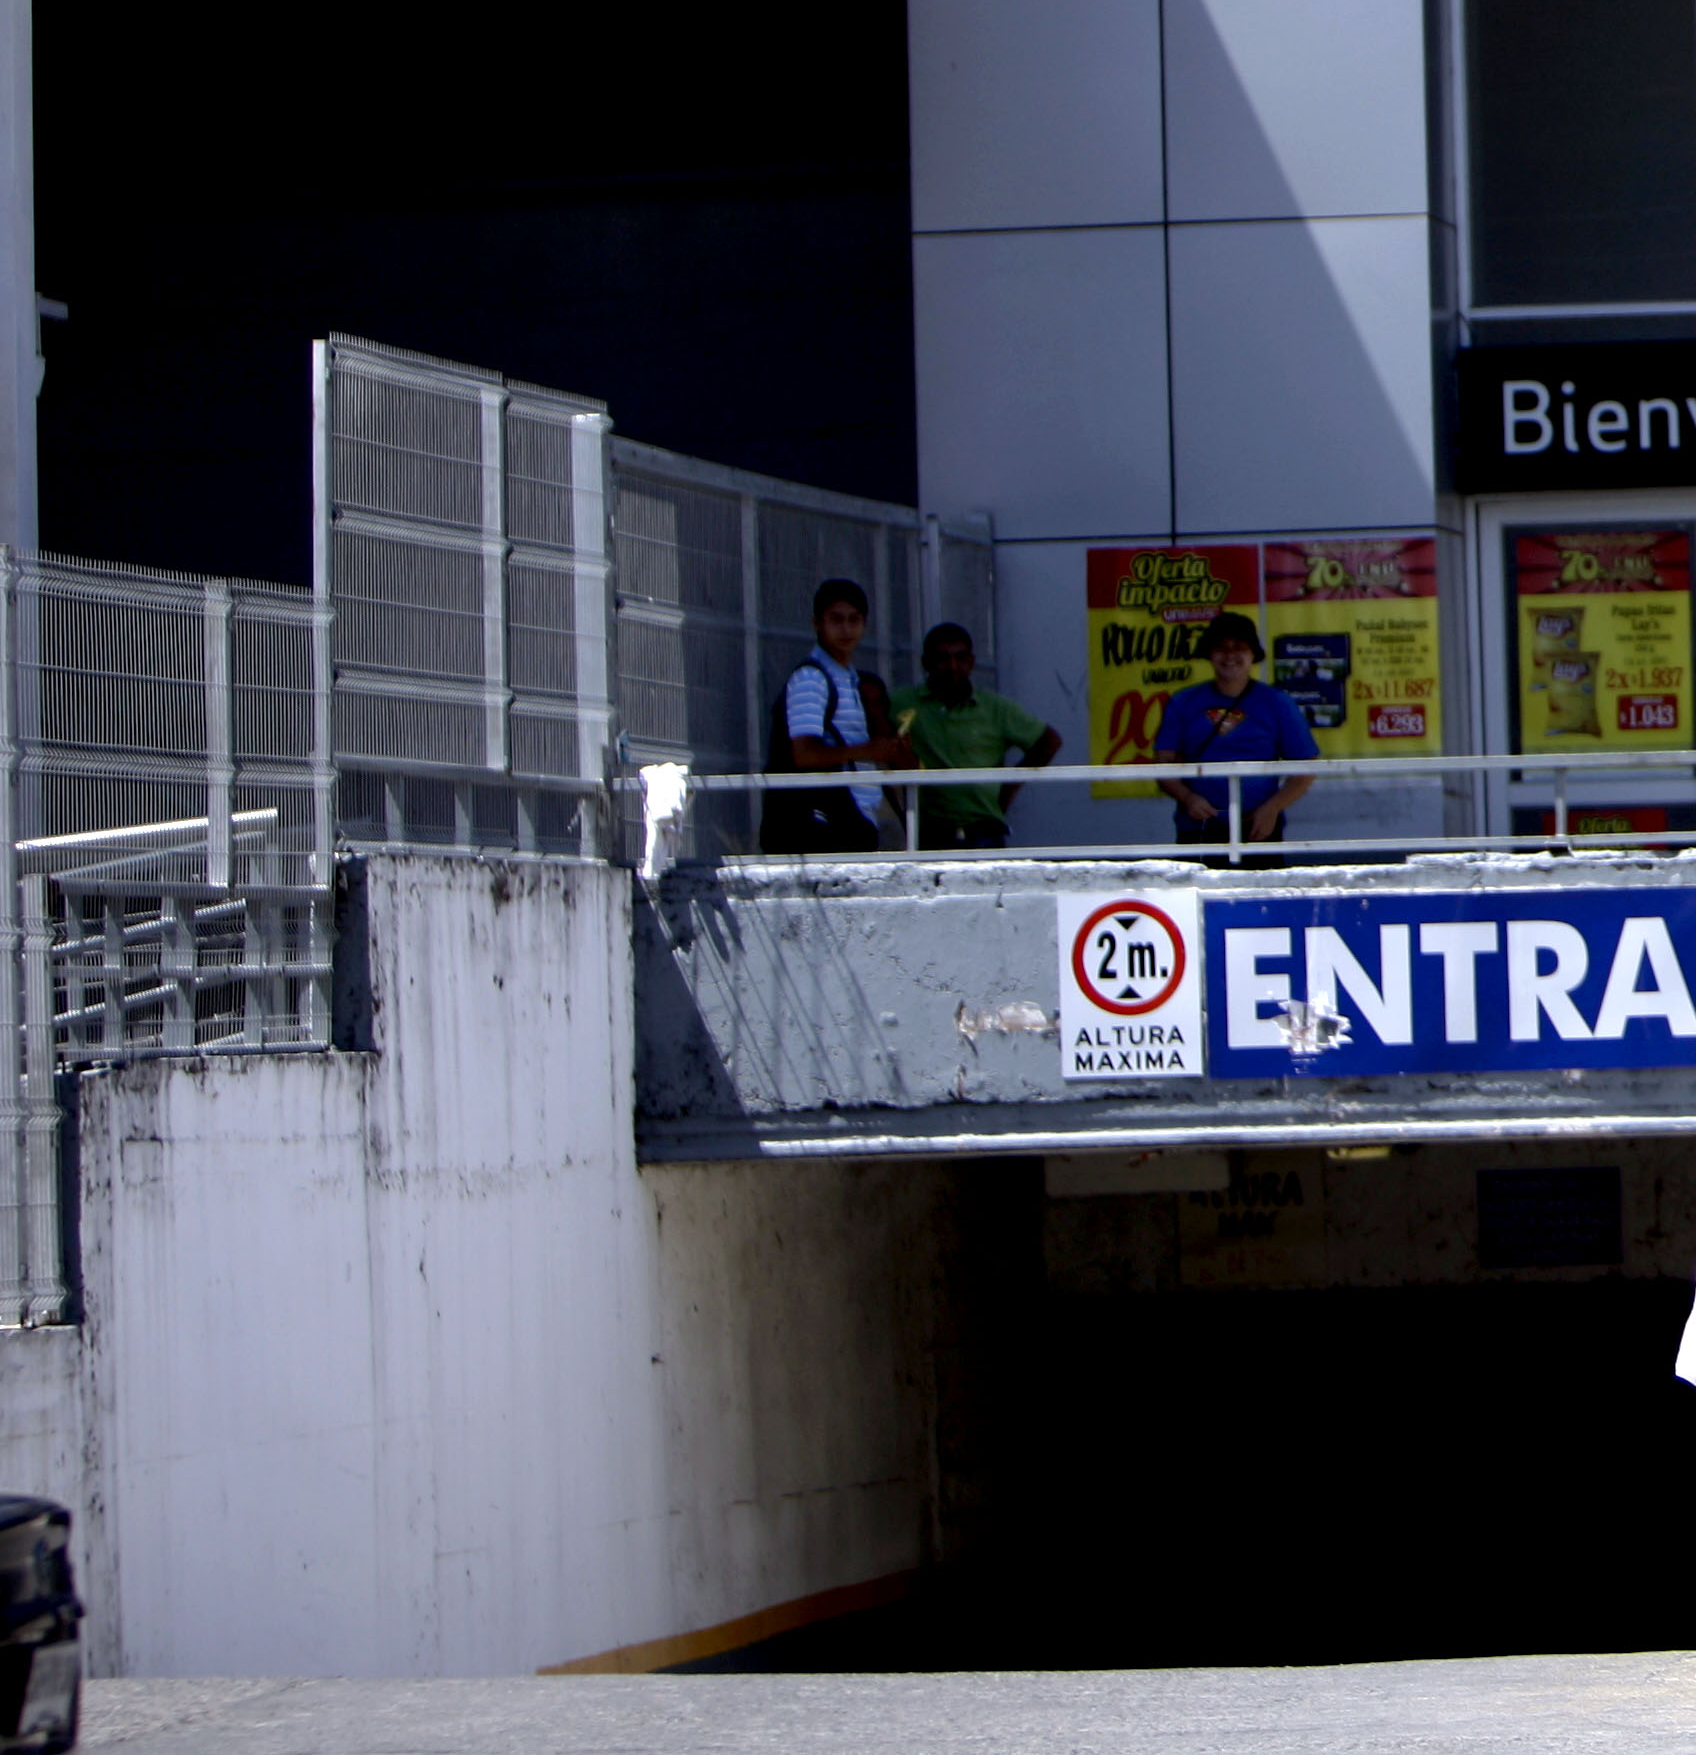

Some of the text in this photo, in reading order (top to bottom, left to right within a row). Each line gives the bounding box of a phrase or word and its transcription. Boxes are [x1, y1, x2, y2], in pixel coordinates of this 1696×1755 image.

[1132, 553, 1209, 584] Oferta
[1117, 575, 1230, 613] impacto
[1097, 930, 1117, 978] 2
[1075, 1025, 1185, 1046] ALTURA
[1075, 1050, 1185, 1072] MAXIMA
